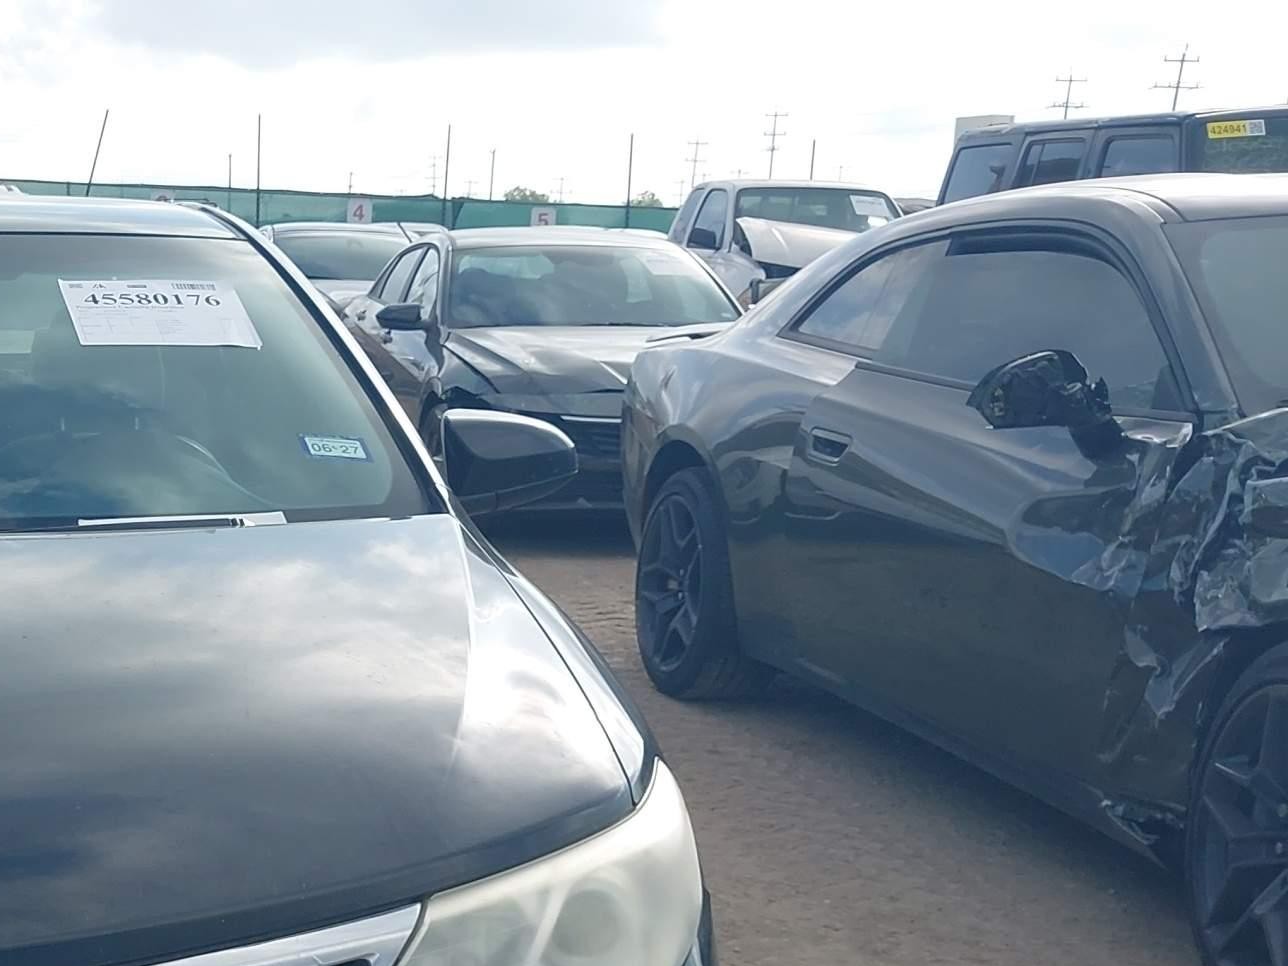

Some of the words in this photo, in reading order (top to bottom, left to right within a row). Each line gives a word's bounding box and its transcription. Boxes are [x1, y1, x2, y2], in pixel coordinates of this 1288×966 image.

[352, 203, 366, 222] 4
[538, 212, 550, 225] 5
[82, 293, 223, 307] 45580176
